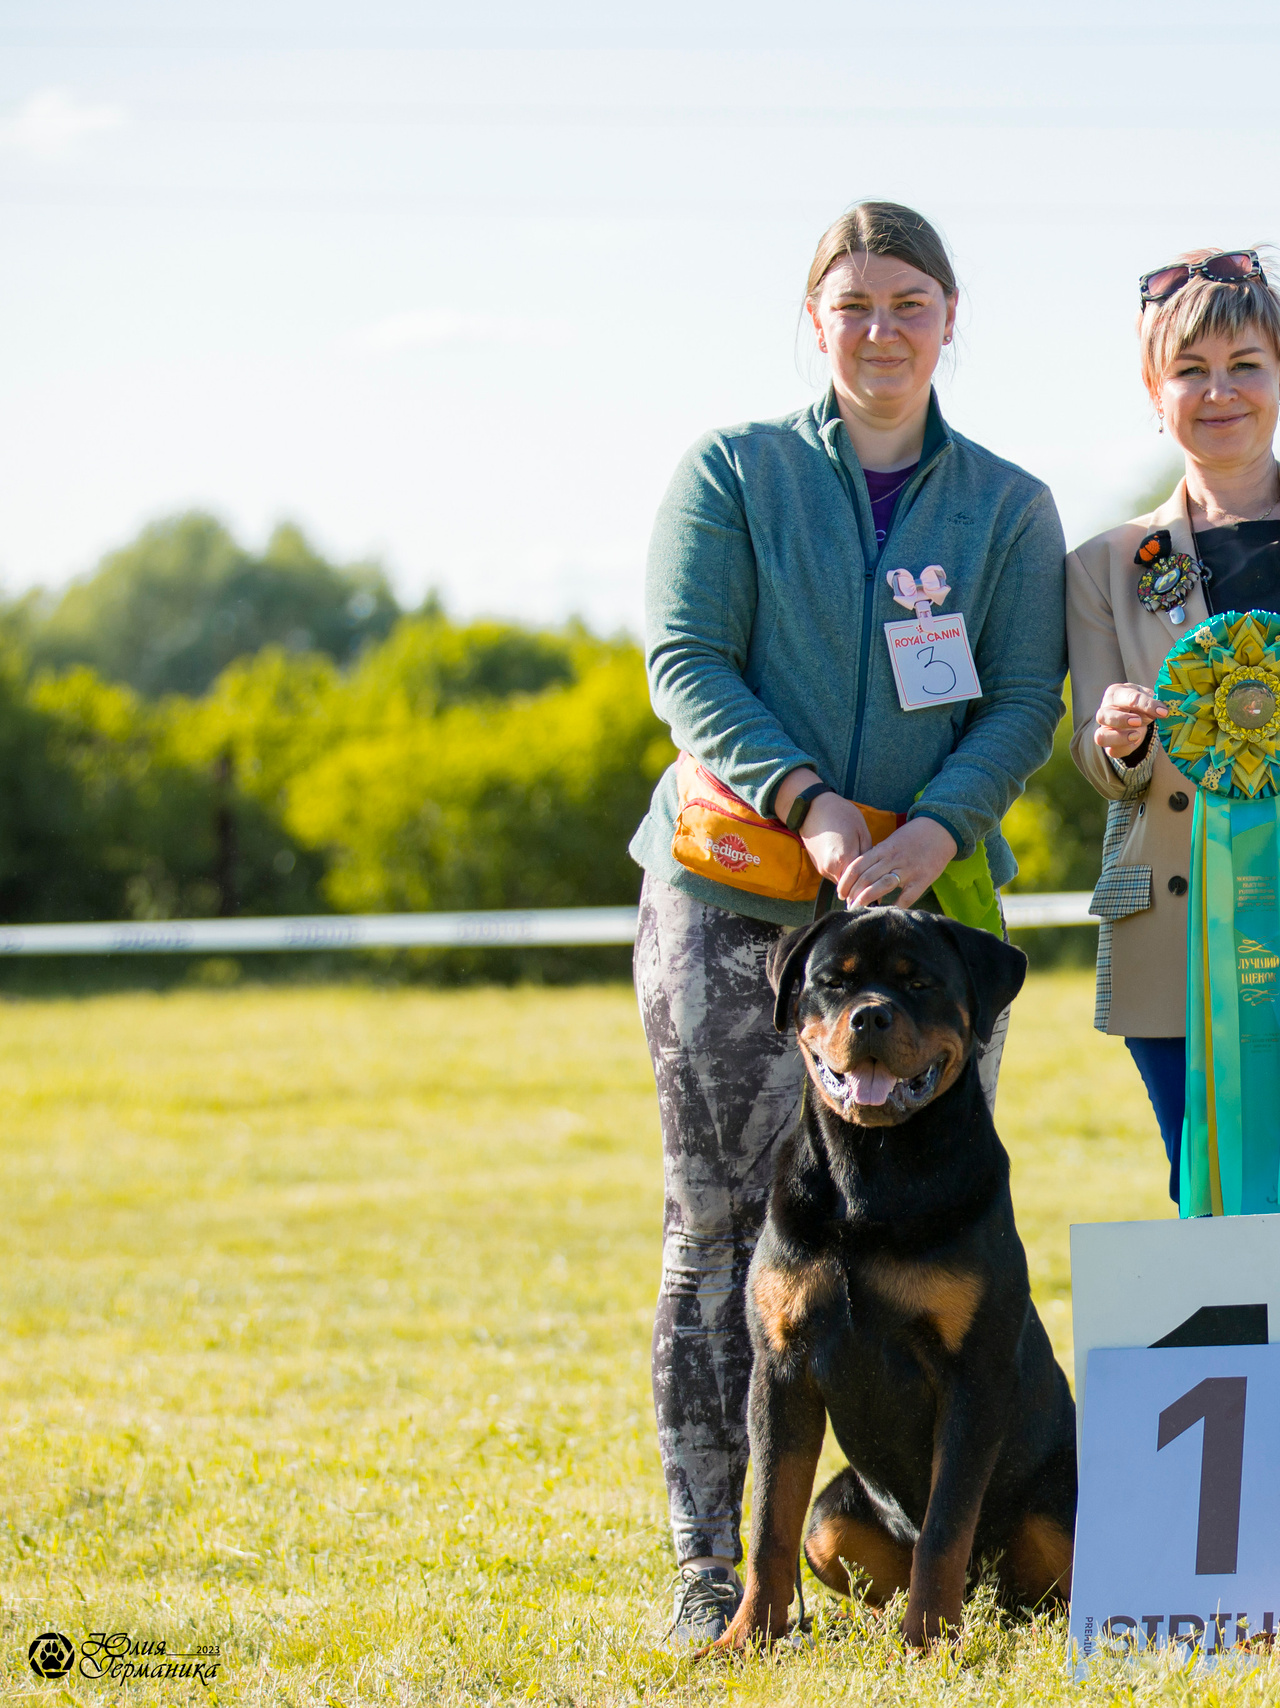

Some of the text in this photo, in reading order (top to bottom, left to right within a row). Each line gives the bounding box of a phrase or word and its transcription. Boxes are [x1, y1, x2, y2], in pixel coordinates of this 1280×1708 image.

[894, 628, 960, 648] ROYAL CANIN
[916, 646, 957, 695] 3
[704, 837, 761, 866] Pedigree
[1238, 955, 1280, 969] ЛУЧШИЙ
[1241, 972, 1277, 985] ЩЕНОК
[1156, 1376, 1248, 1576] 1
